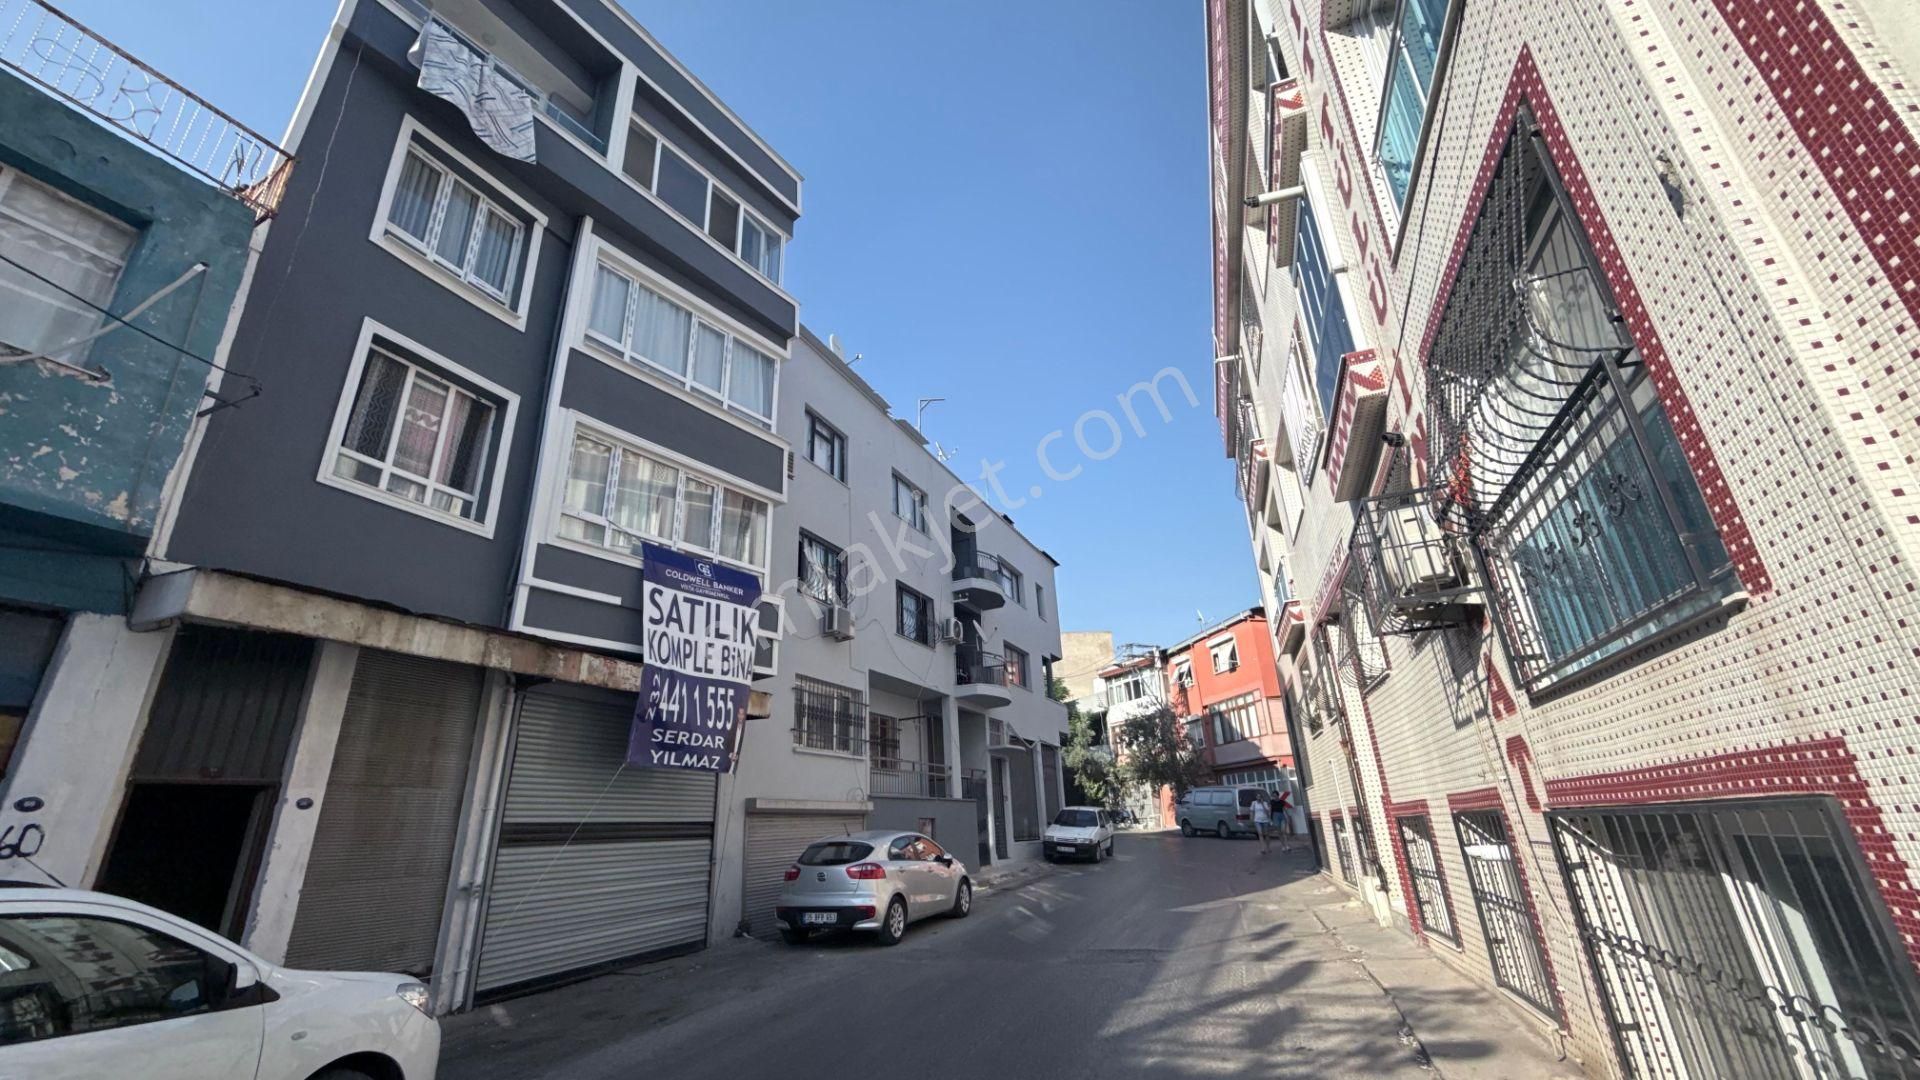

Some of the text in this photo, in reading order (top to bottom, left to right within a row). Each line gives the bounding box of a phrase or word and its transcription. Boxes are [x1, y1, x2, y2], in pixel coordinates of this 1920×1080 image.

[665, 568, 744, 597] COLDWELL BANKER
[648, 587, 756, 647] SATILIK
[647, 628, 715, 675] KOMPLE
[706, 686, 734, 731] 555
[650, 728, 725, 750] SERDAR
[650, 749, 720, 770] YILMAZ
